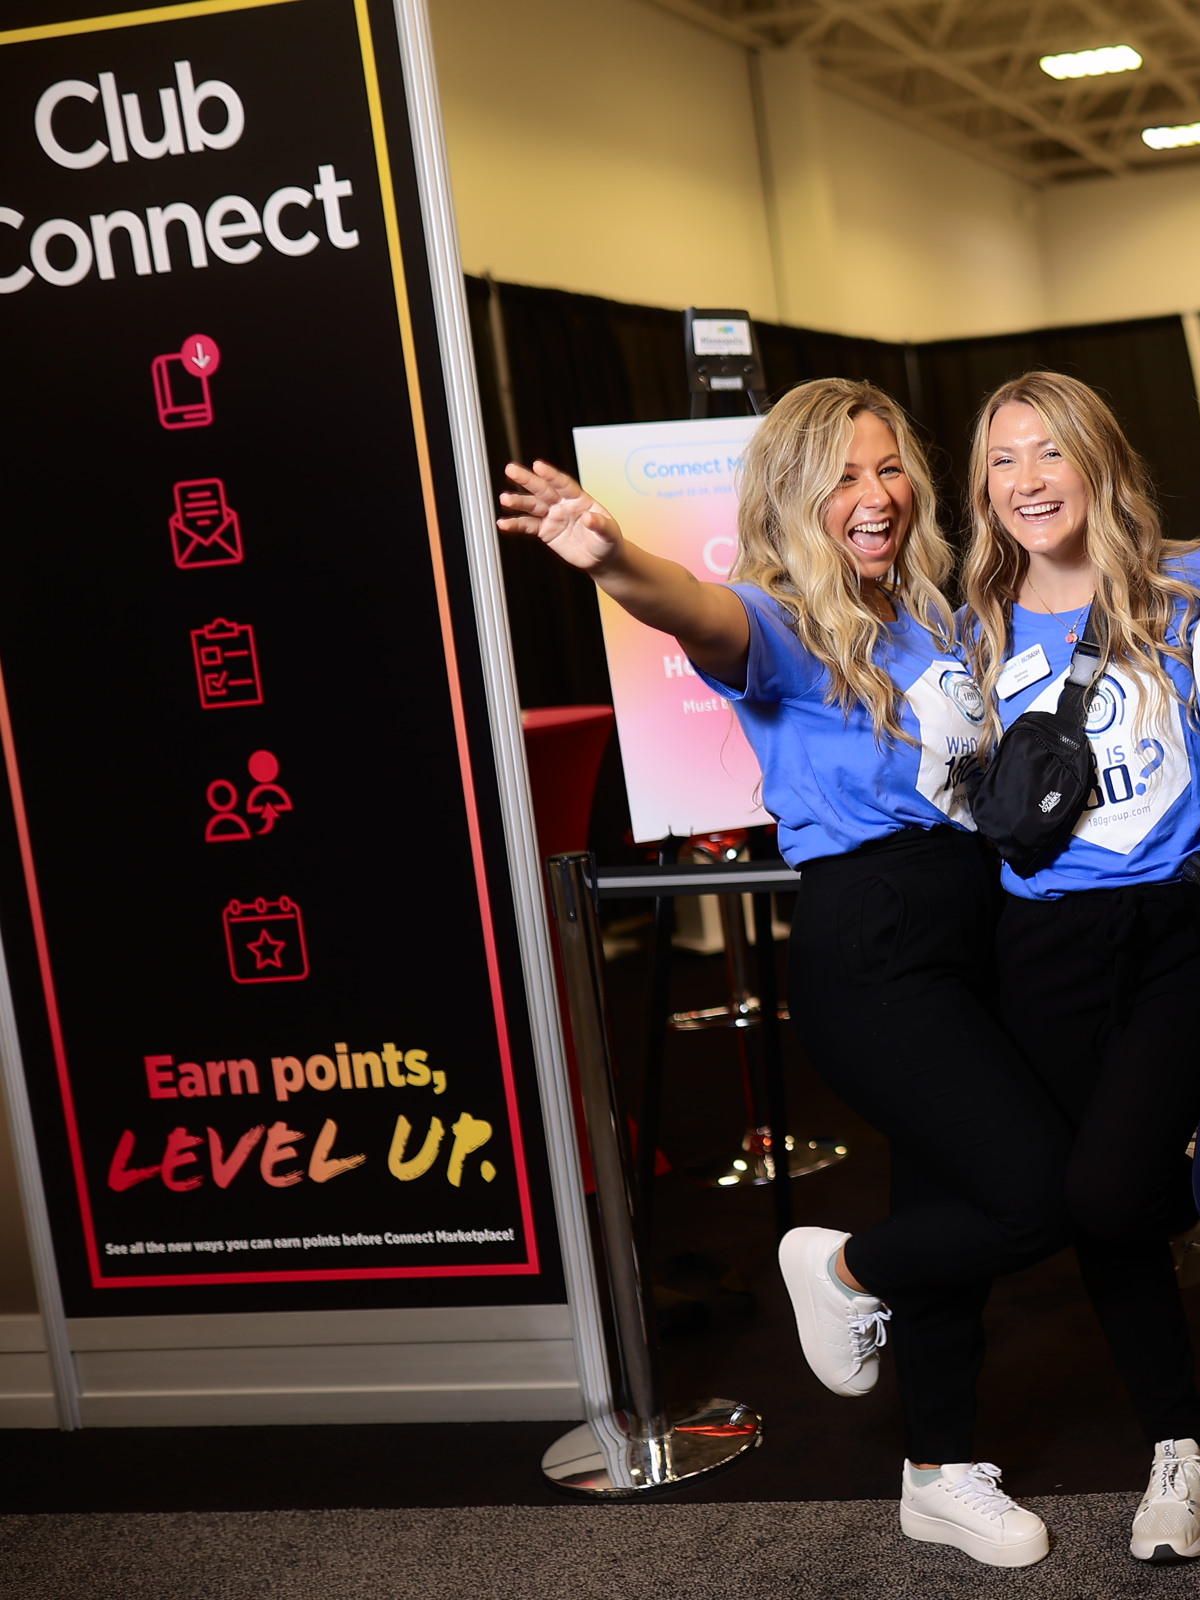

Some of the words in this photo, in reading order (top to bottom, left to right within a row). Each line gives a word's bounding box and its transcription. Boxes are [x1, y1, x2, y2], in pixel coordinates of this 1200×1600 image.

[34, 60, 245, 170] Club
[643, 459, 722, 479] Connect
[683, 698, 719, 715] Must
[945, 735, 978, 755] WHO
[1106, 745, 1126, 766] IS
[1087, 804, 1152, 829] 180group.com
[143, 1054, 260, 1100] Earn
[270, 1041, 447, 1102] points,
[108, 1117, 367, 1192] LEVEL
[387, 1111, 497, 1188] UP.
[105, 1242, 129, 1255] See
[130, 1241, 146, 1254] all
[146, 1241, 167, 1253] the
[167, 1241, 193, 1252] new
[194, 1240, 225, 1253] ways
[225, 1239, 249, 1252] you
[250, 1238, 273, 1249] can
[273, 1236, 301, 1249] earn
[302, 1234, 341, 1250] points
[342, 1232, 383, 1246] before
[384, 1230, 435, 1245] Connect
[436, 1227, 516, 1244] Marketplace!
